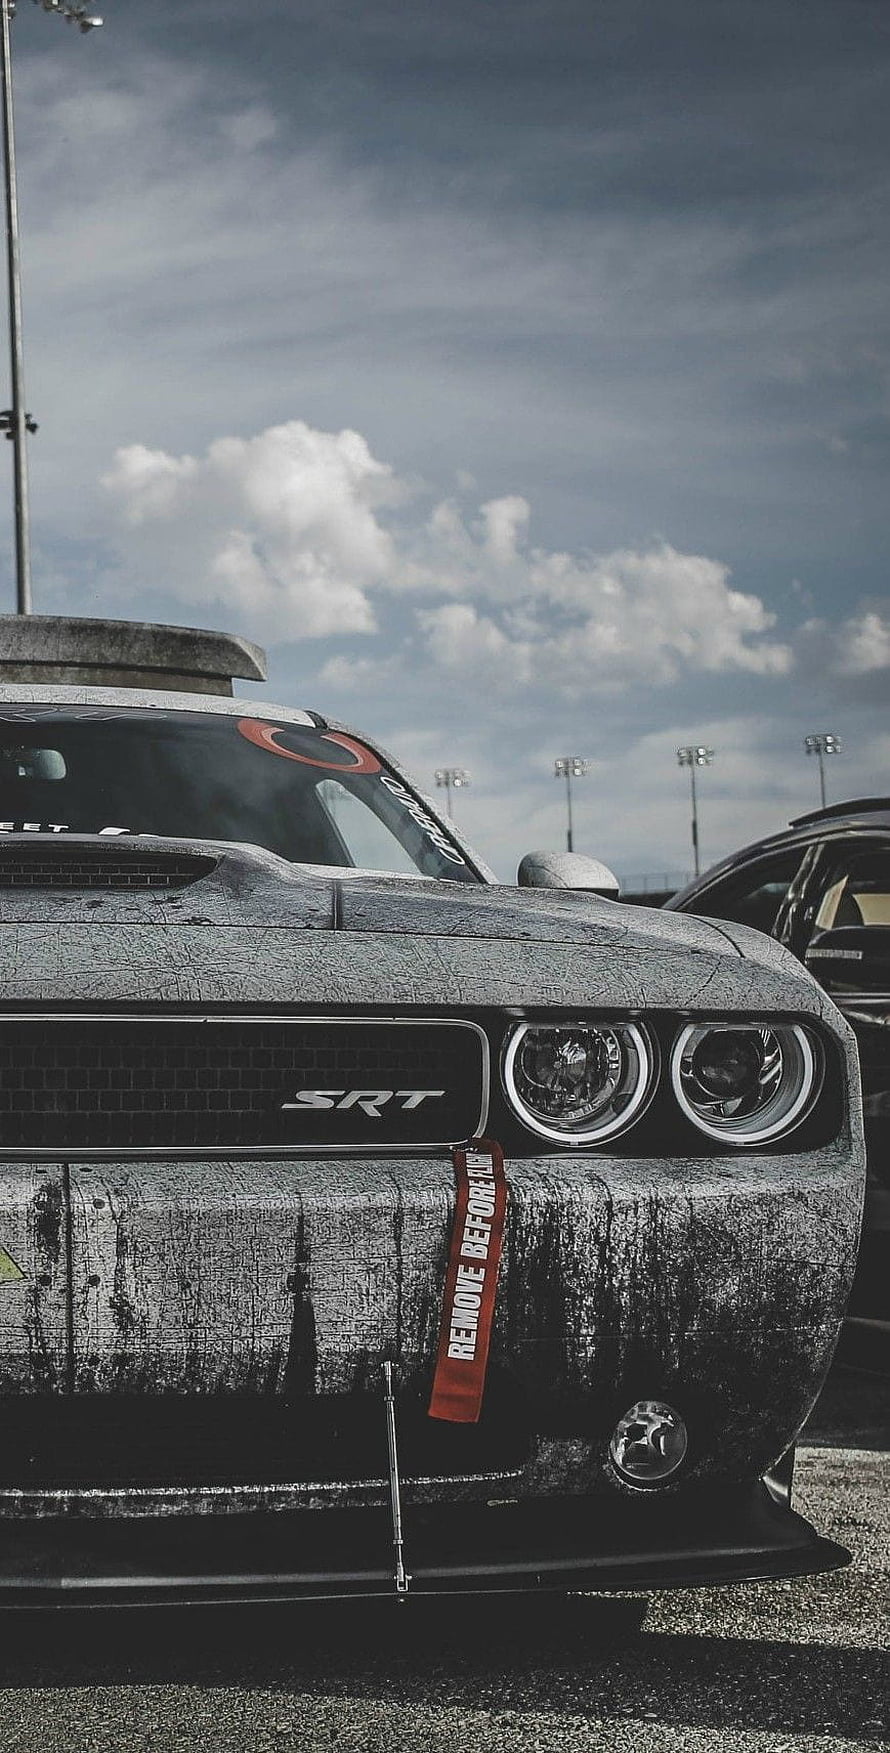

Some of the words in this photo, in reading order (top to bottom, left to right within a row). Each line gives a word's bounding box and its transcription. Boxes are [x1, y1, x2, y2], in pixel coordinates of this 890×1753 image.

[281, 1090, 445, 1117] SRT
[460, 1179, 496, 1260] BEFORE
[448, 1264, 486, 1361] REMOVE
